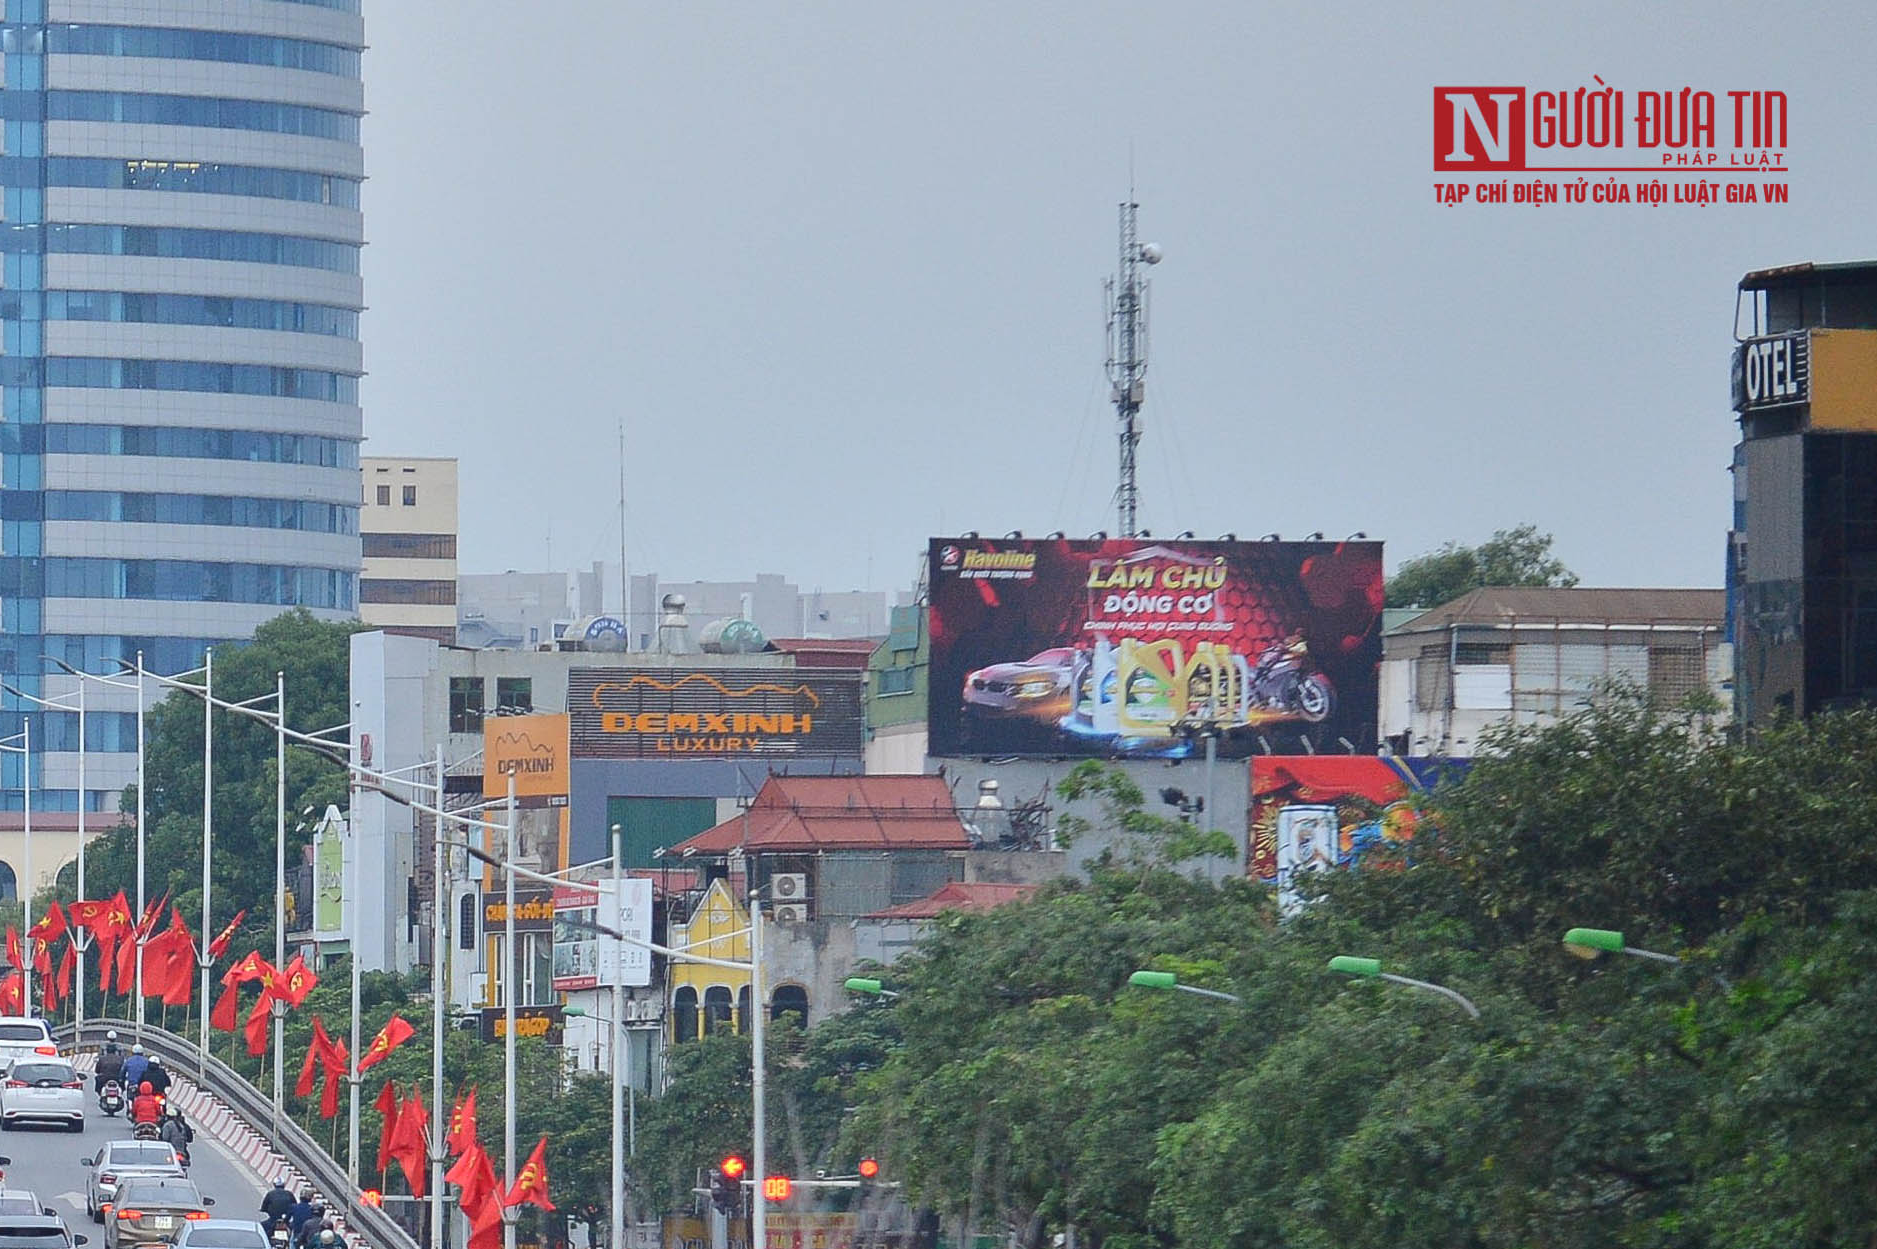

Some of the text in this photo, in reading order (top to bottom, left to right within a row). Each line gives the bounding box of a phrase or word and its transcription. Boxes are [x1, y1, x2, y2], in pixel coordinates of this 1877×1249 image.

[1746, 339, 1797, 400] OTEL
[963, 549, 1036, 568] Havoline
[1162, 556, 1227, 589] CHỦ
[1103, 590, 1213, 617] ĐỘNG CƠ
[602, 713, 811, 732] DEMXINH
[656, 737, 758, 751] LUXURY
[765, 1178, 788, 1197] 08
